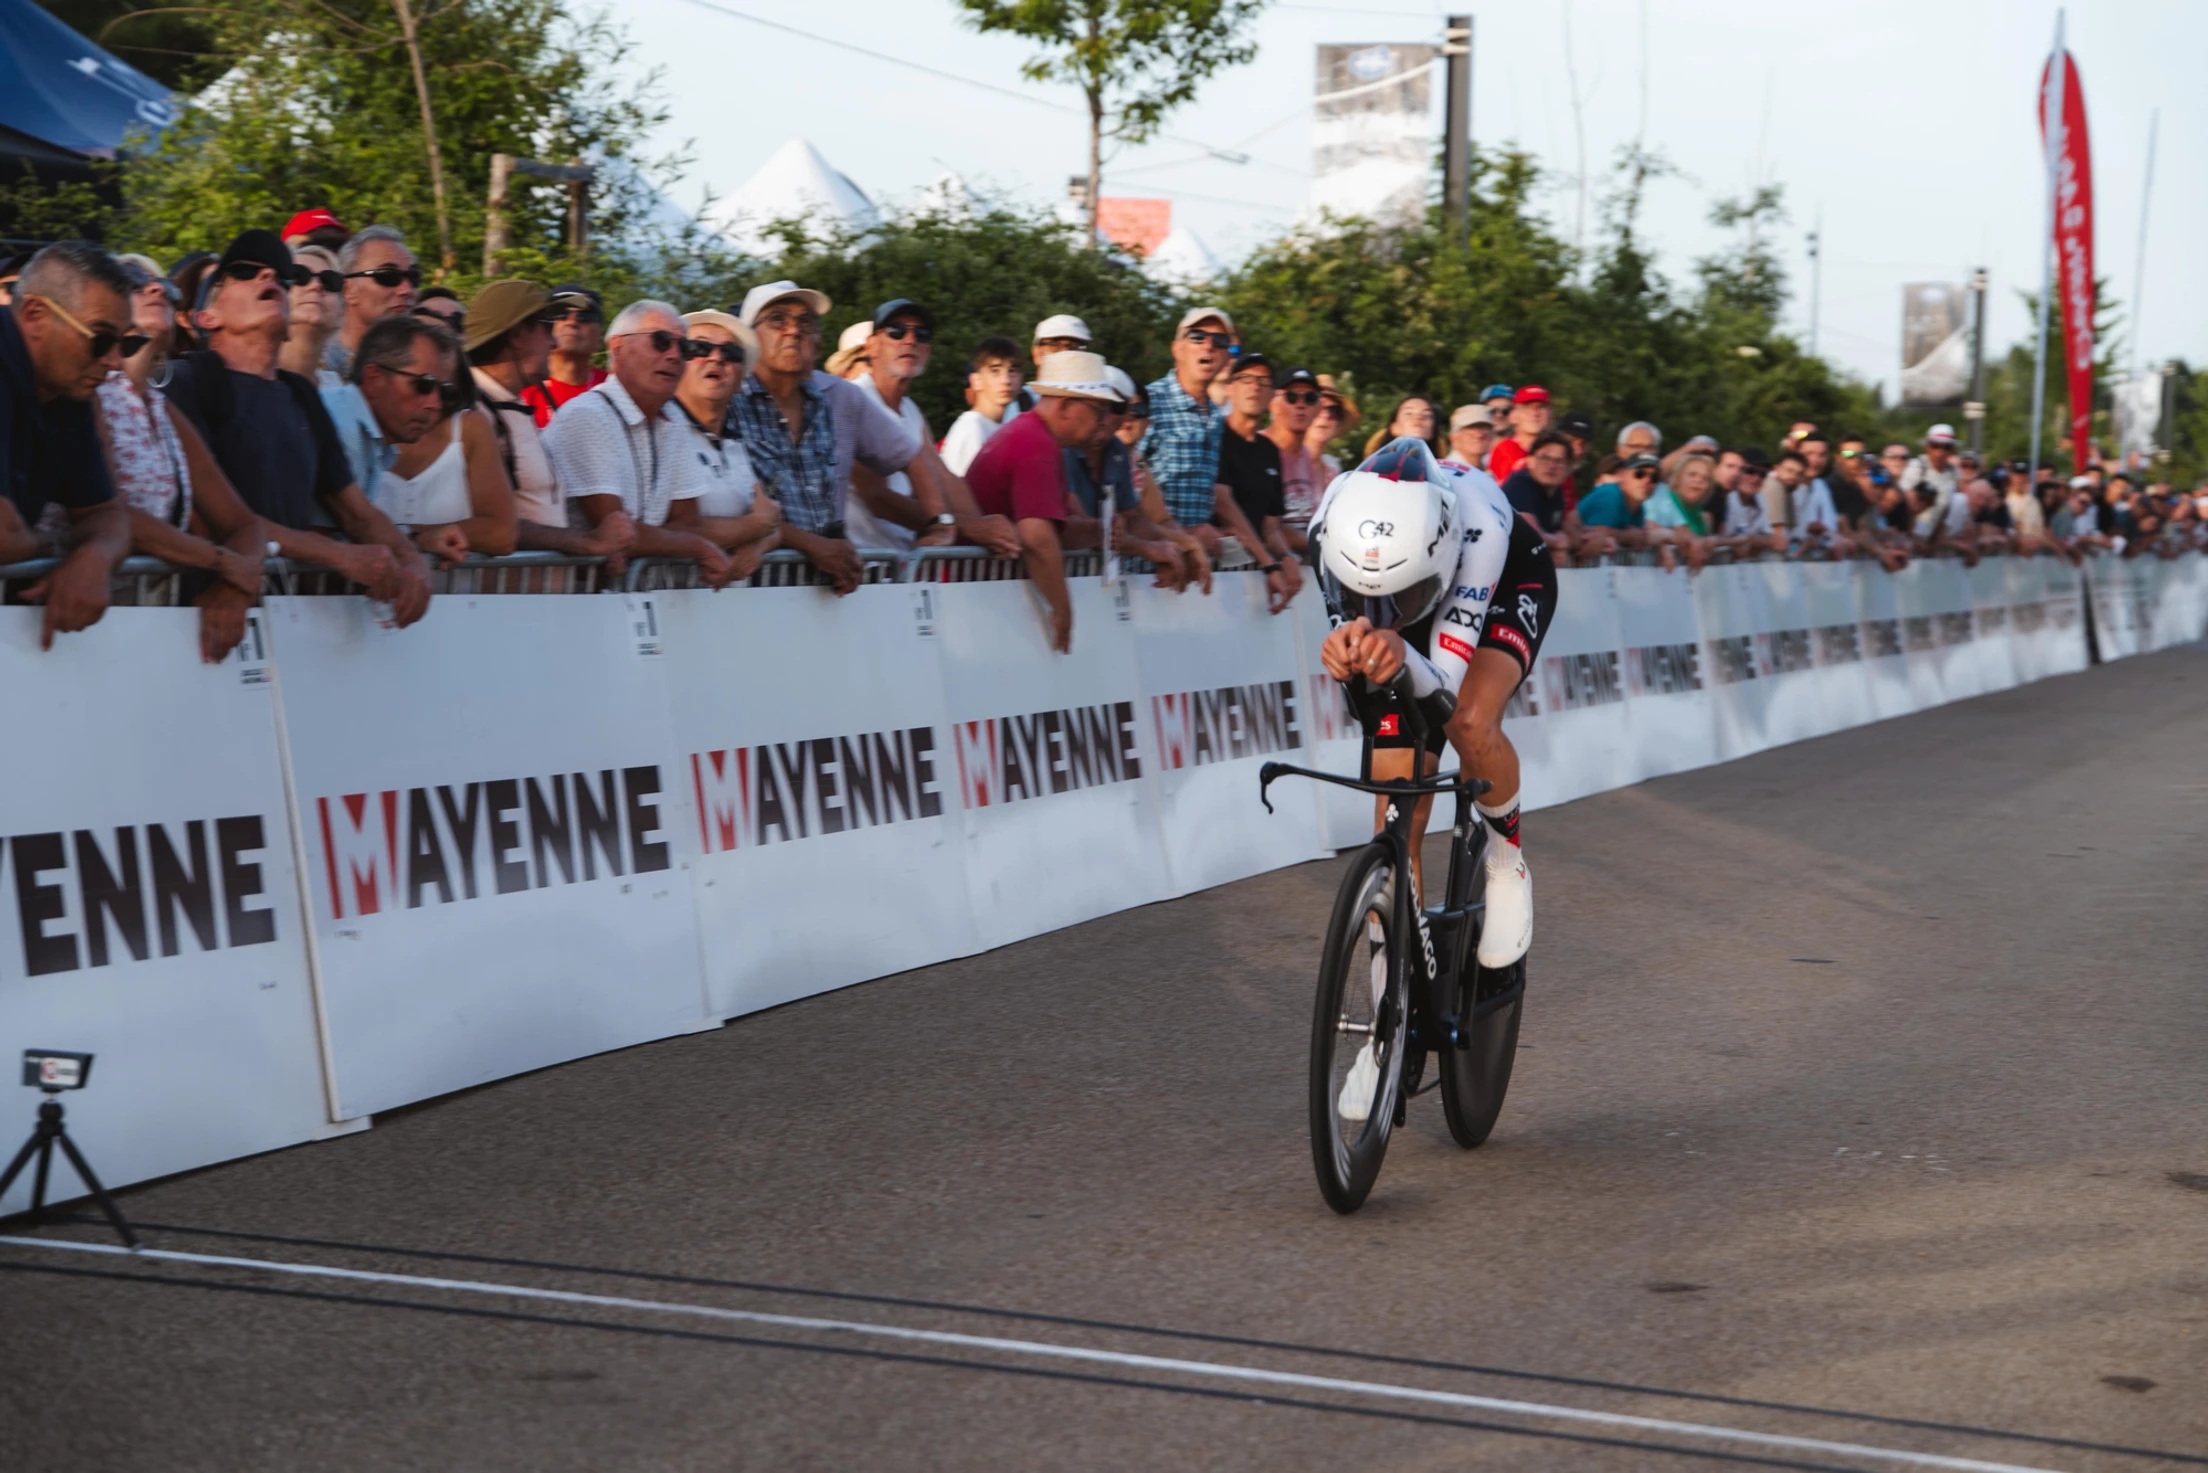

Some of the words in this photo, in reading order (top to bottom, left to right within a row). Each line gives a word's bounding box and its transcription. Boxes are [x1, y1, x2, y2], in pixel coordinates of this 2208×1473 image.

[1358, 519, 1395, 539] G42
[953, 701, 1143, 809] MAYENNE
[1151, 680, 1303, 771] MAYENNE
[317, 765, 671, 920] MAYENNE
[691, 726, 943, 854] MAYENNE
[0, 814, 279, 977] ENNE
